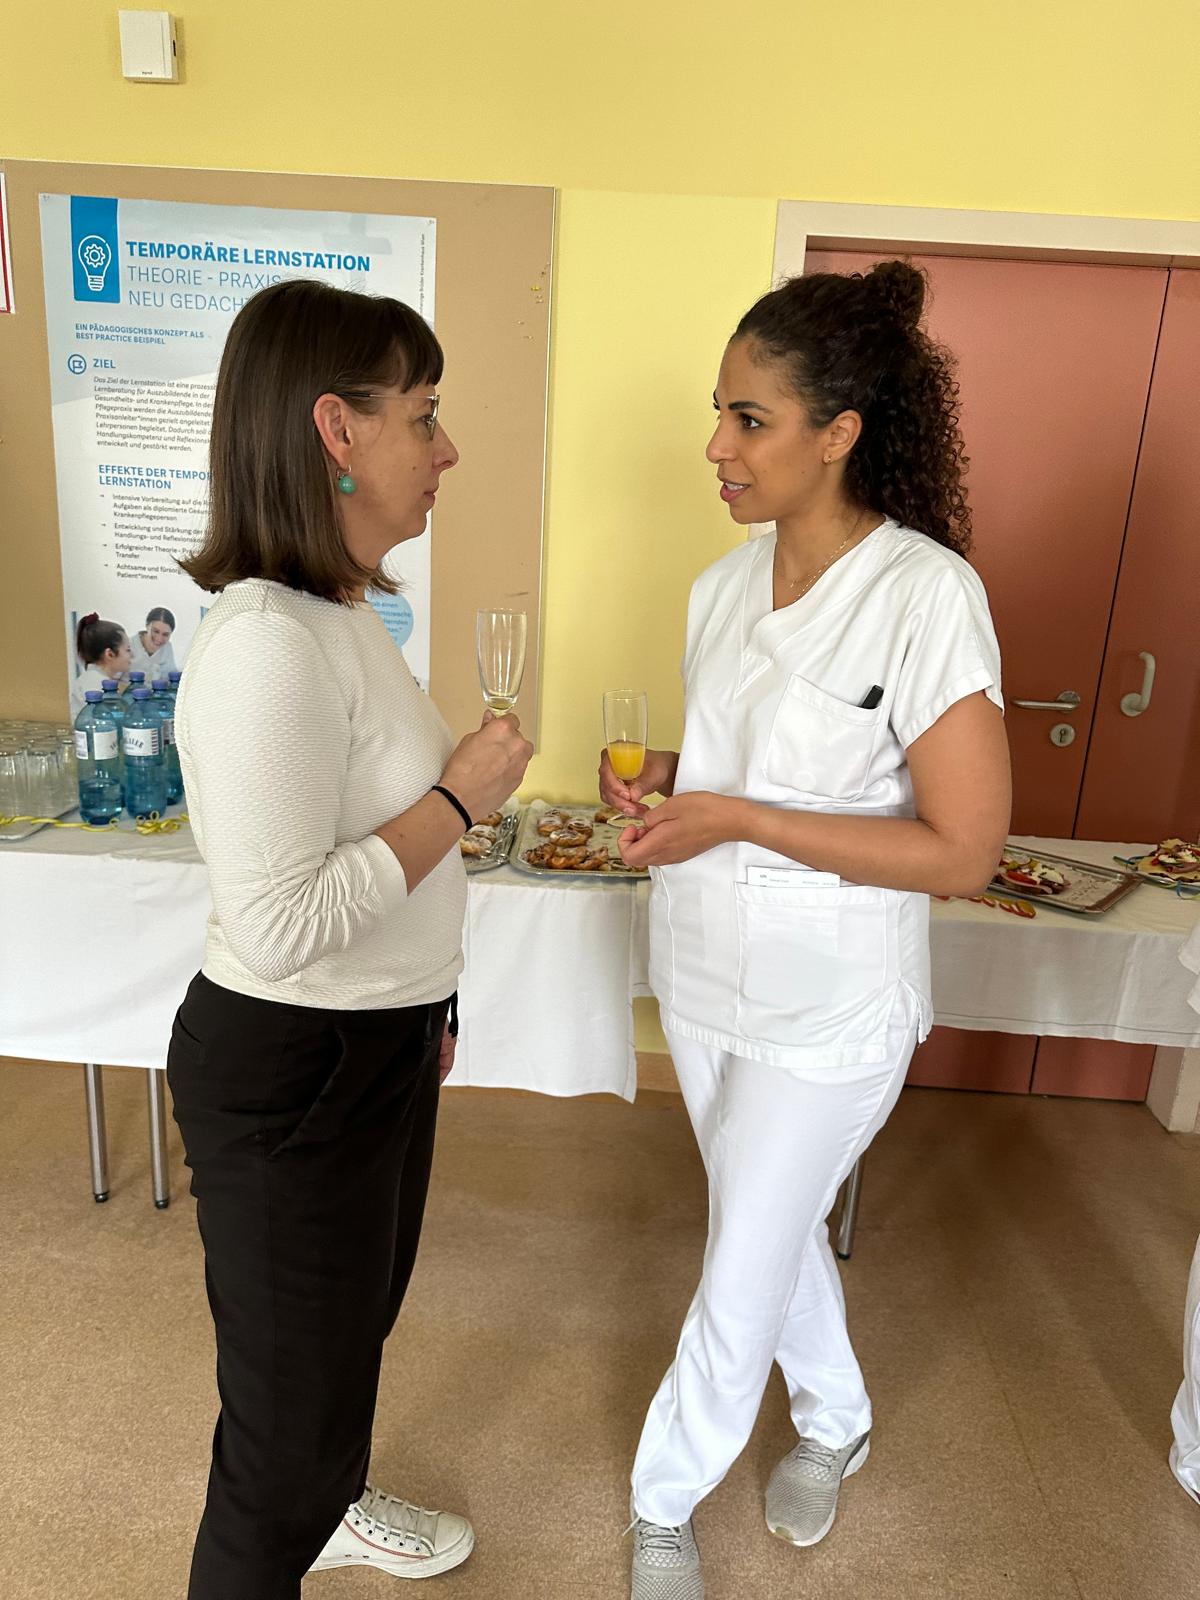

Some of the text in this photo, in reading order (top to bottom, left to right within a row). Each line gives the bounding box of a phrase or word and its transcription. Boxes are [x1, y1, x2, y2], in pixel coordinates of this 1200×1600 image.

[125, 240, 371, 272] TEMPORÄRE LERNSTATION
[127, 265, 202, 286] THEORIE
[128, 290, 248, 312] NEU GEDACH
[75, 323, 88, 332] EIN
[89, 323, 153, 336] PÄDAGOGISCHES
[154, 329, 188, 337] KONZEPT
[95, 334, 132, 342] PRACTICE
[134, 336, 166, 345] BEISPIEL
[92, 358, 116, 369] ZIEL
[130, 379, 166, 388] Lernstation
[168, 409, 212, 417] Auszubildende
[98, 464, 144, 476] EFFEKTE
[146, 468, 167, 478] DER
[99, 476, 172, 490] LERNSTATION
[160, 566, 182, 575] fürsorg
